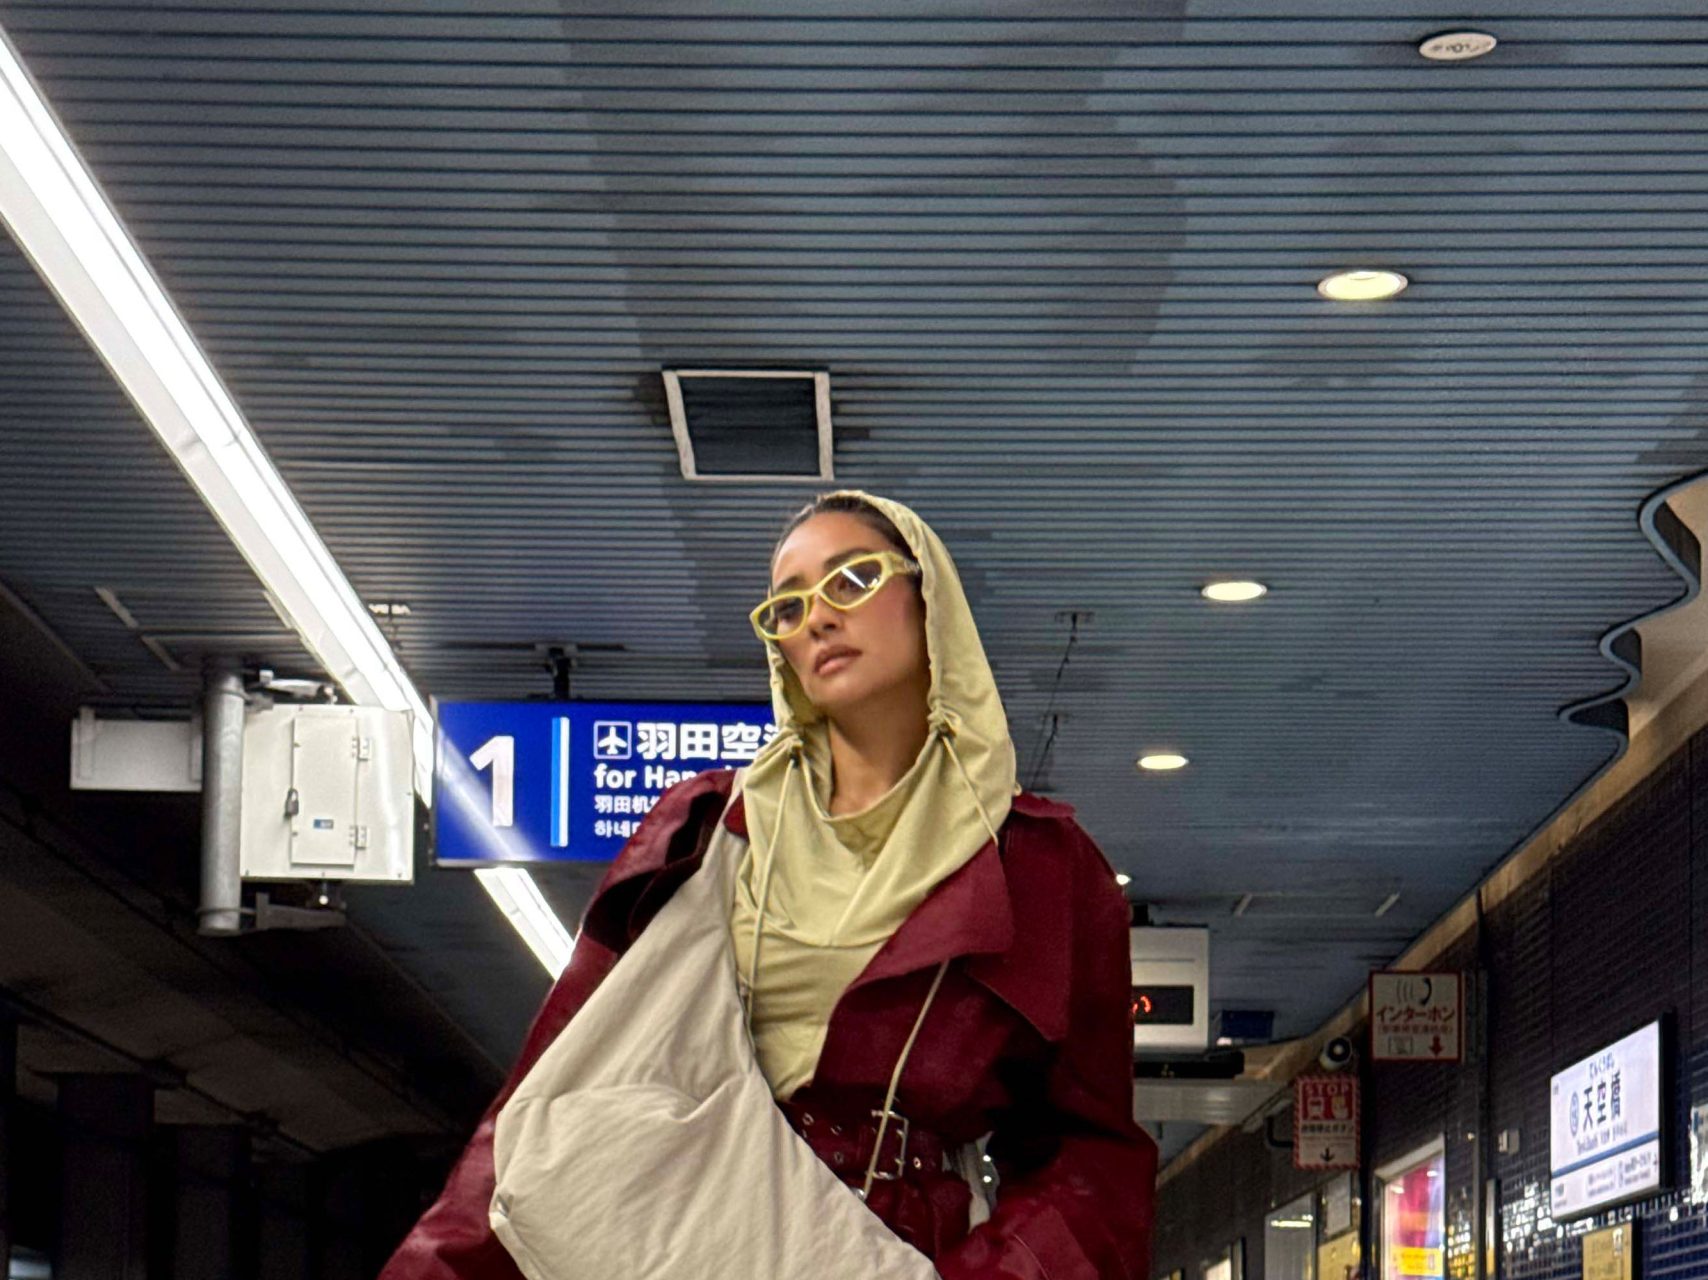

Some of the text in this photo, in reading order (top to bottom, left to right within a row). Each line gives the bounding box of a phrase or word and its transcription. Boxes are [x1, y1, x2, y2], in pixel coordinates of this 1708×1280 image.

[469, 735, 515, 827] 1
[593, 763, 637, 789] for
[594, 820, 641, 838] 하네
[1376, 1005, 1455, 1023] インターホン
[1304, 1082, 1351, 1096] STOP
